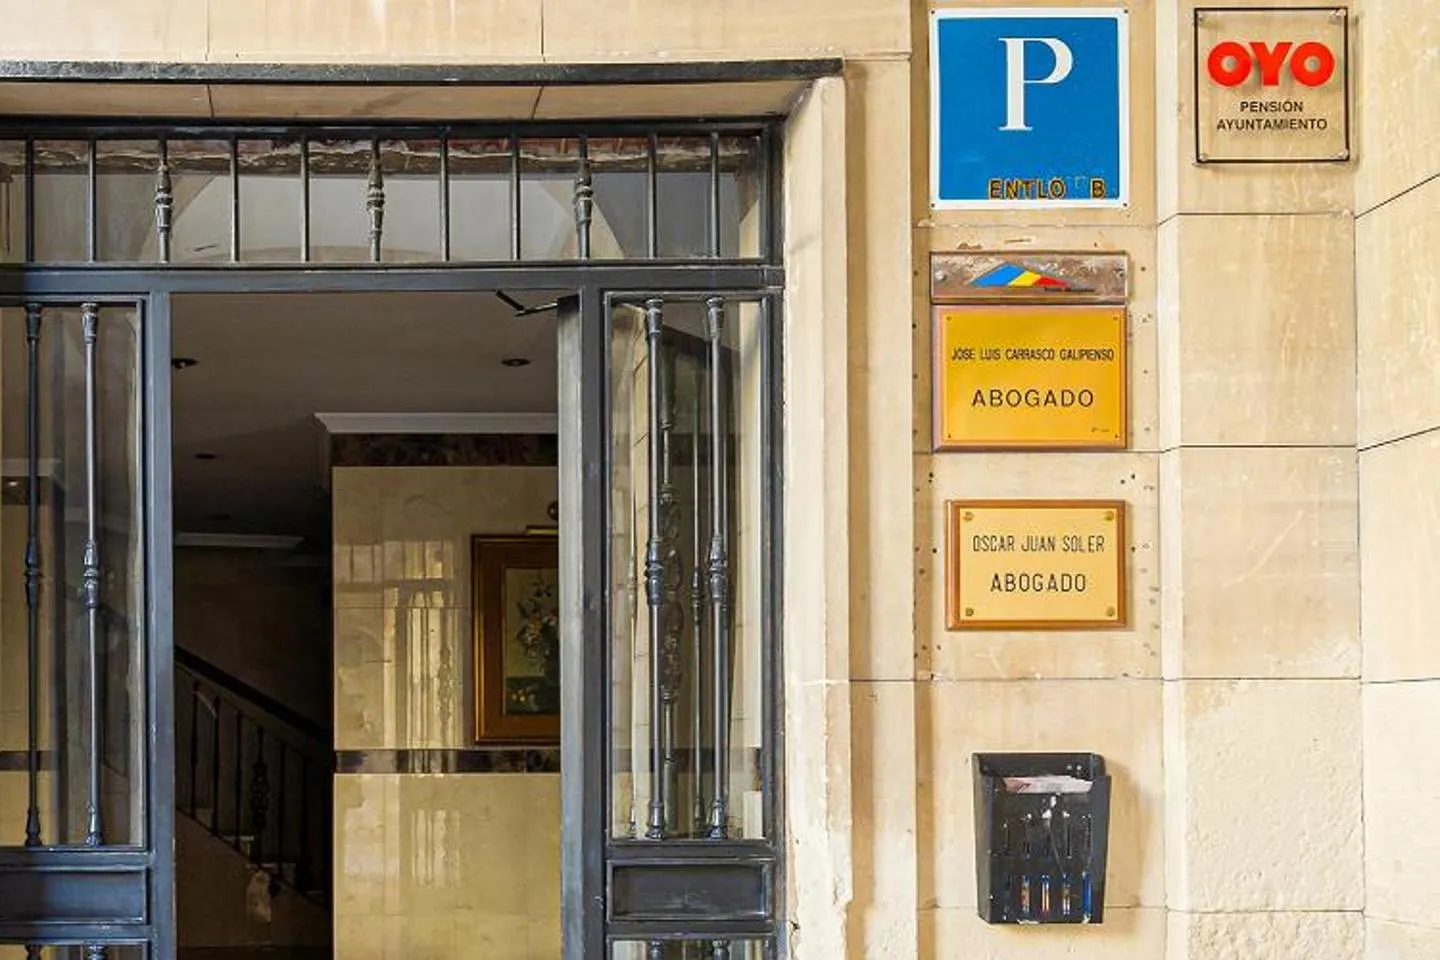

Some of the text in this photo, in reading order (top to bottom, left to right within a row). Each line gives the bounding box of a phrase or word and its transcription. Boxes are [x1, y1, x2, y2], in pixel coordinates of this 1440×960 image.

[1207, 41, 1335, 87] OYO
[998, 37, 1073, 131] P
[1216, 118, 1328, 130] AYUNTAMIENTO
[1090, 178, 1106, 200] B
[952, 348, 975, 360] JOSE
[980, 348, 1001, 360] LUIS
[1006, 348, 1055, 360] CARRASCO
[972, 389, 1095, 407] ABOGADO
[973, 535, 1106, 552] OSCAR JUAN SOLER
[990, 573, 1087, 592] ABOGADO
